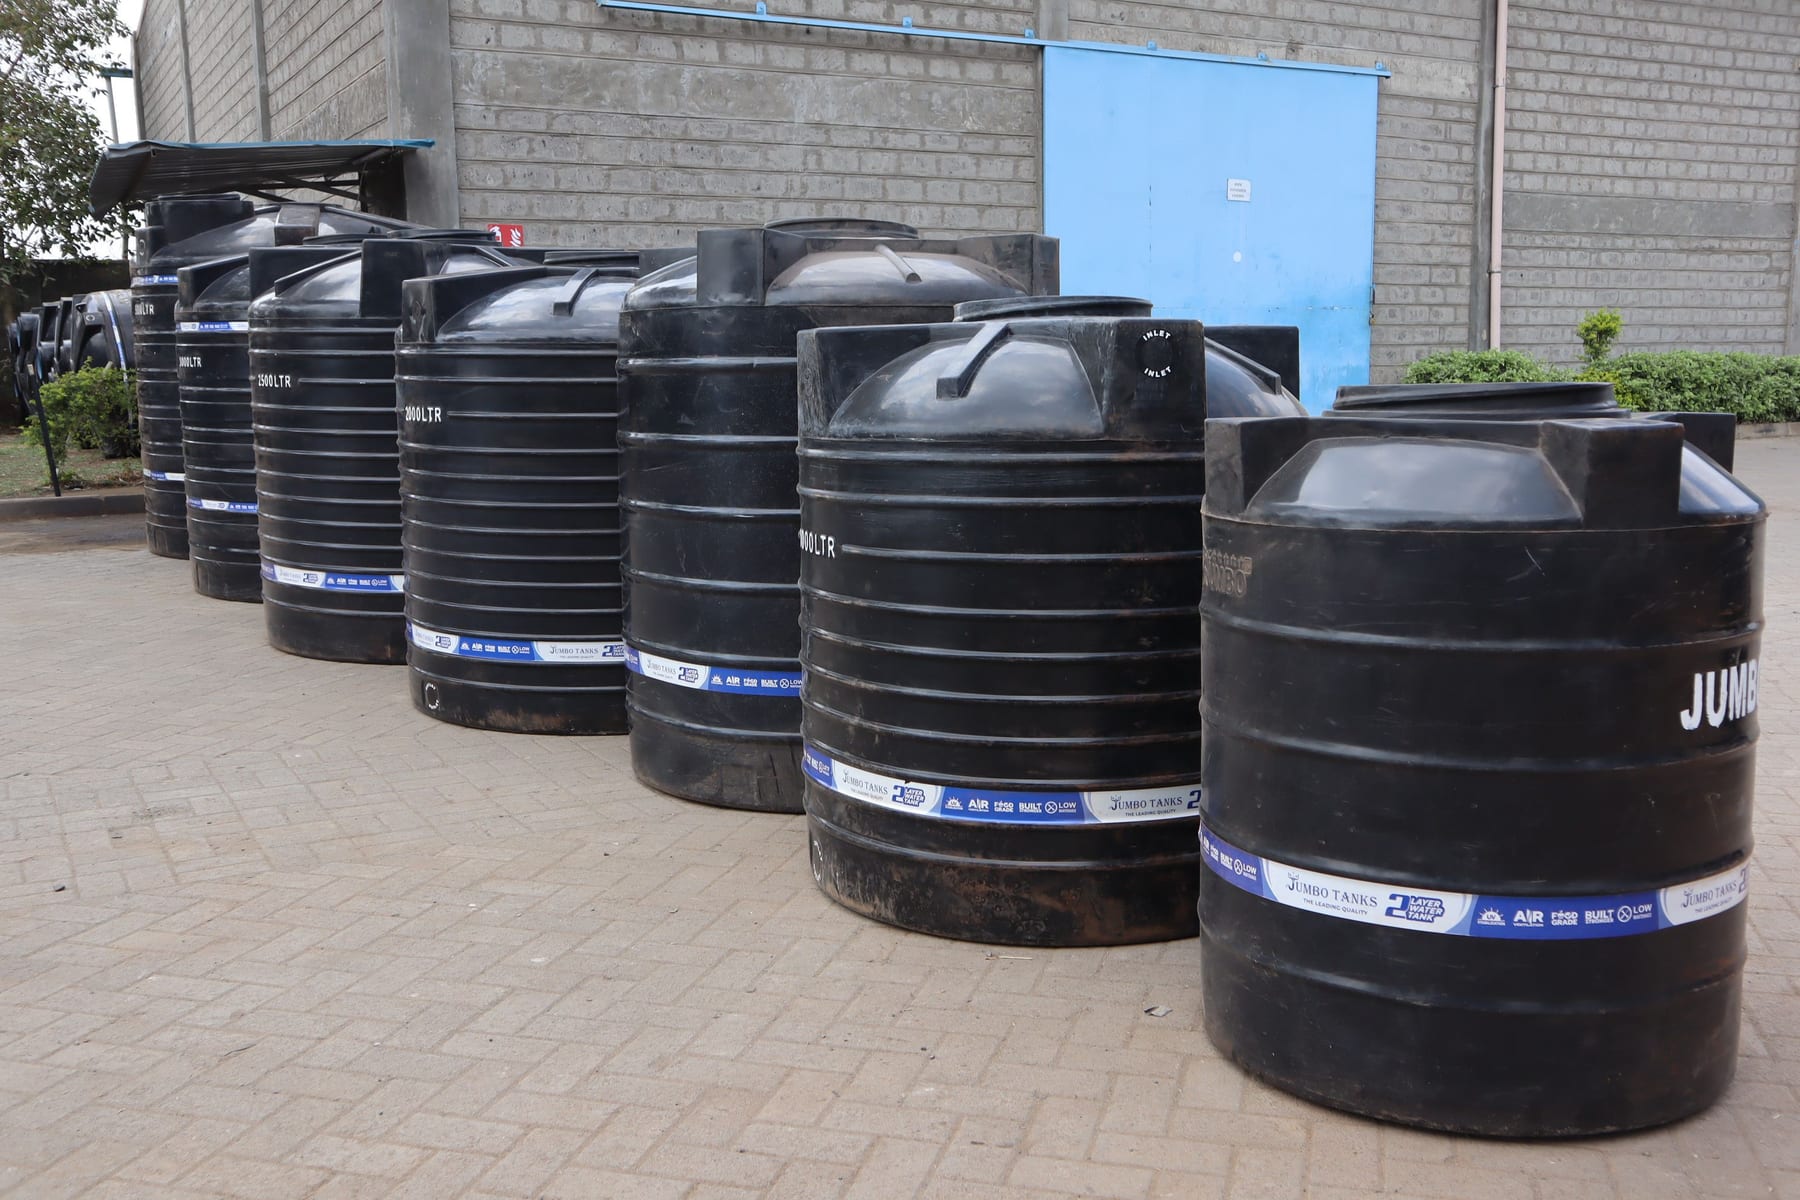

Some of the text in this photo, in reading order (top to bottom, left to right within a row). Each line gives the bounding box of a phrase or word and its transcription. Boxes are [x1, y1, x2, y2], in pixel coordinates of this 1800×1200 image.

[1143, 329, 1171, 341] INLET
[1144, 366, 1171, 378] INLET
[258, 373, 291, 388] 2500LTR
[726, 676, 741, 684] AIR
[1680, 659, 1758, 731] JUMB
[864, 780, 888, 796] TANKS
[968, 799, 989, 809] AIR
[1110, 796, 1183, 811] JUMBO TANKS
[1187, 789, 1201, 809] 2
[1019, 802, 1042, 810] BUILT
[1243, 863, 1257, 875] LOW
[1287, 877, 1378, 907] JUMBO TANKS
[1682, 880, 1737, 908] JUMBO TANKS
[1315, 900, 1341, 911] LEADING
[1342, 906, 1368, 916] QUALITY
[1385, 893, 1441, 919] 2 LAYER
[1409, 905, 1443, 916] WATER
[1633, 904, 1653, 914] LOW
[1408, 911, 1433, 922] TANK
[1514, 909, 1544, 923] AIR
[1585, 909, 1614, 920] BUILT
